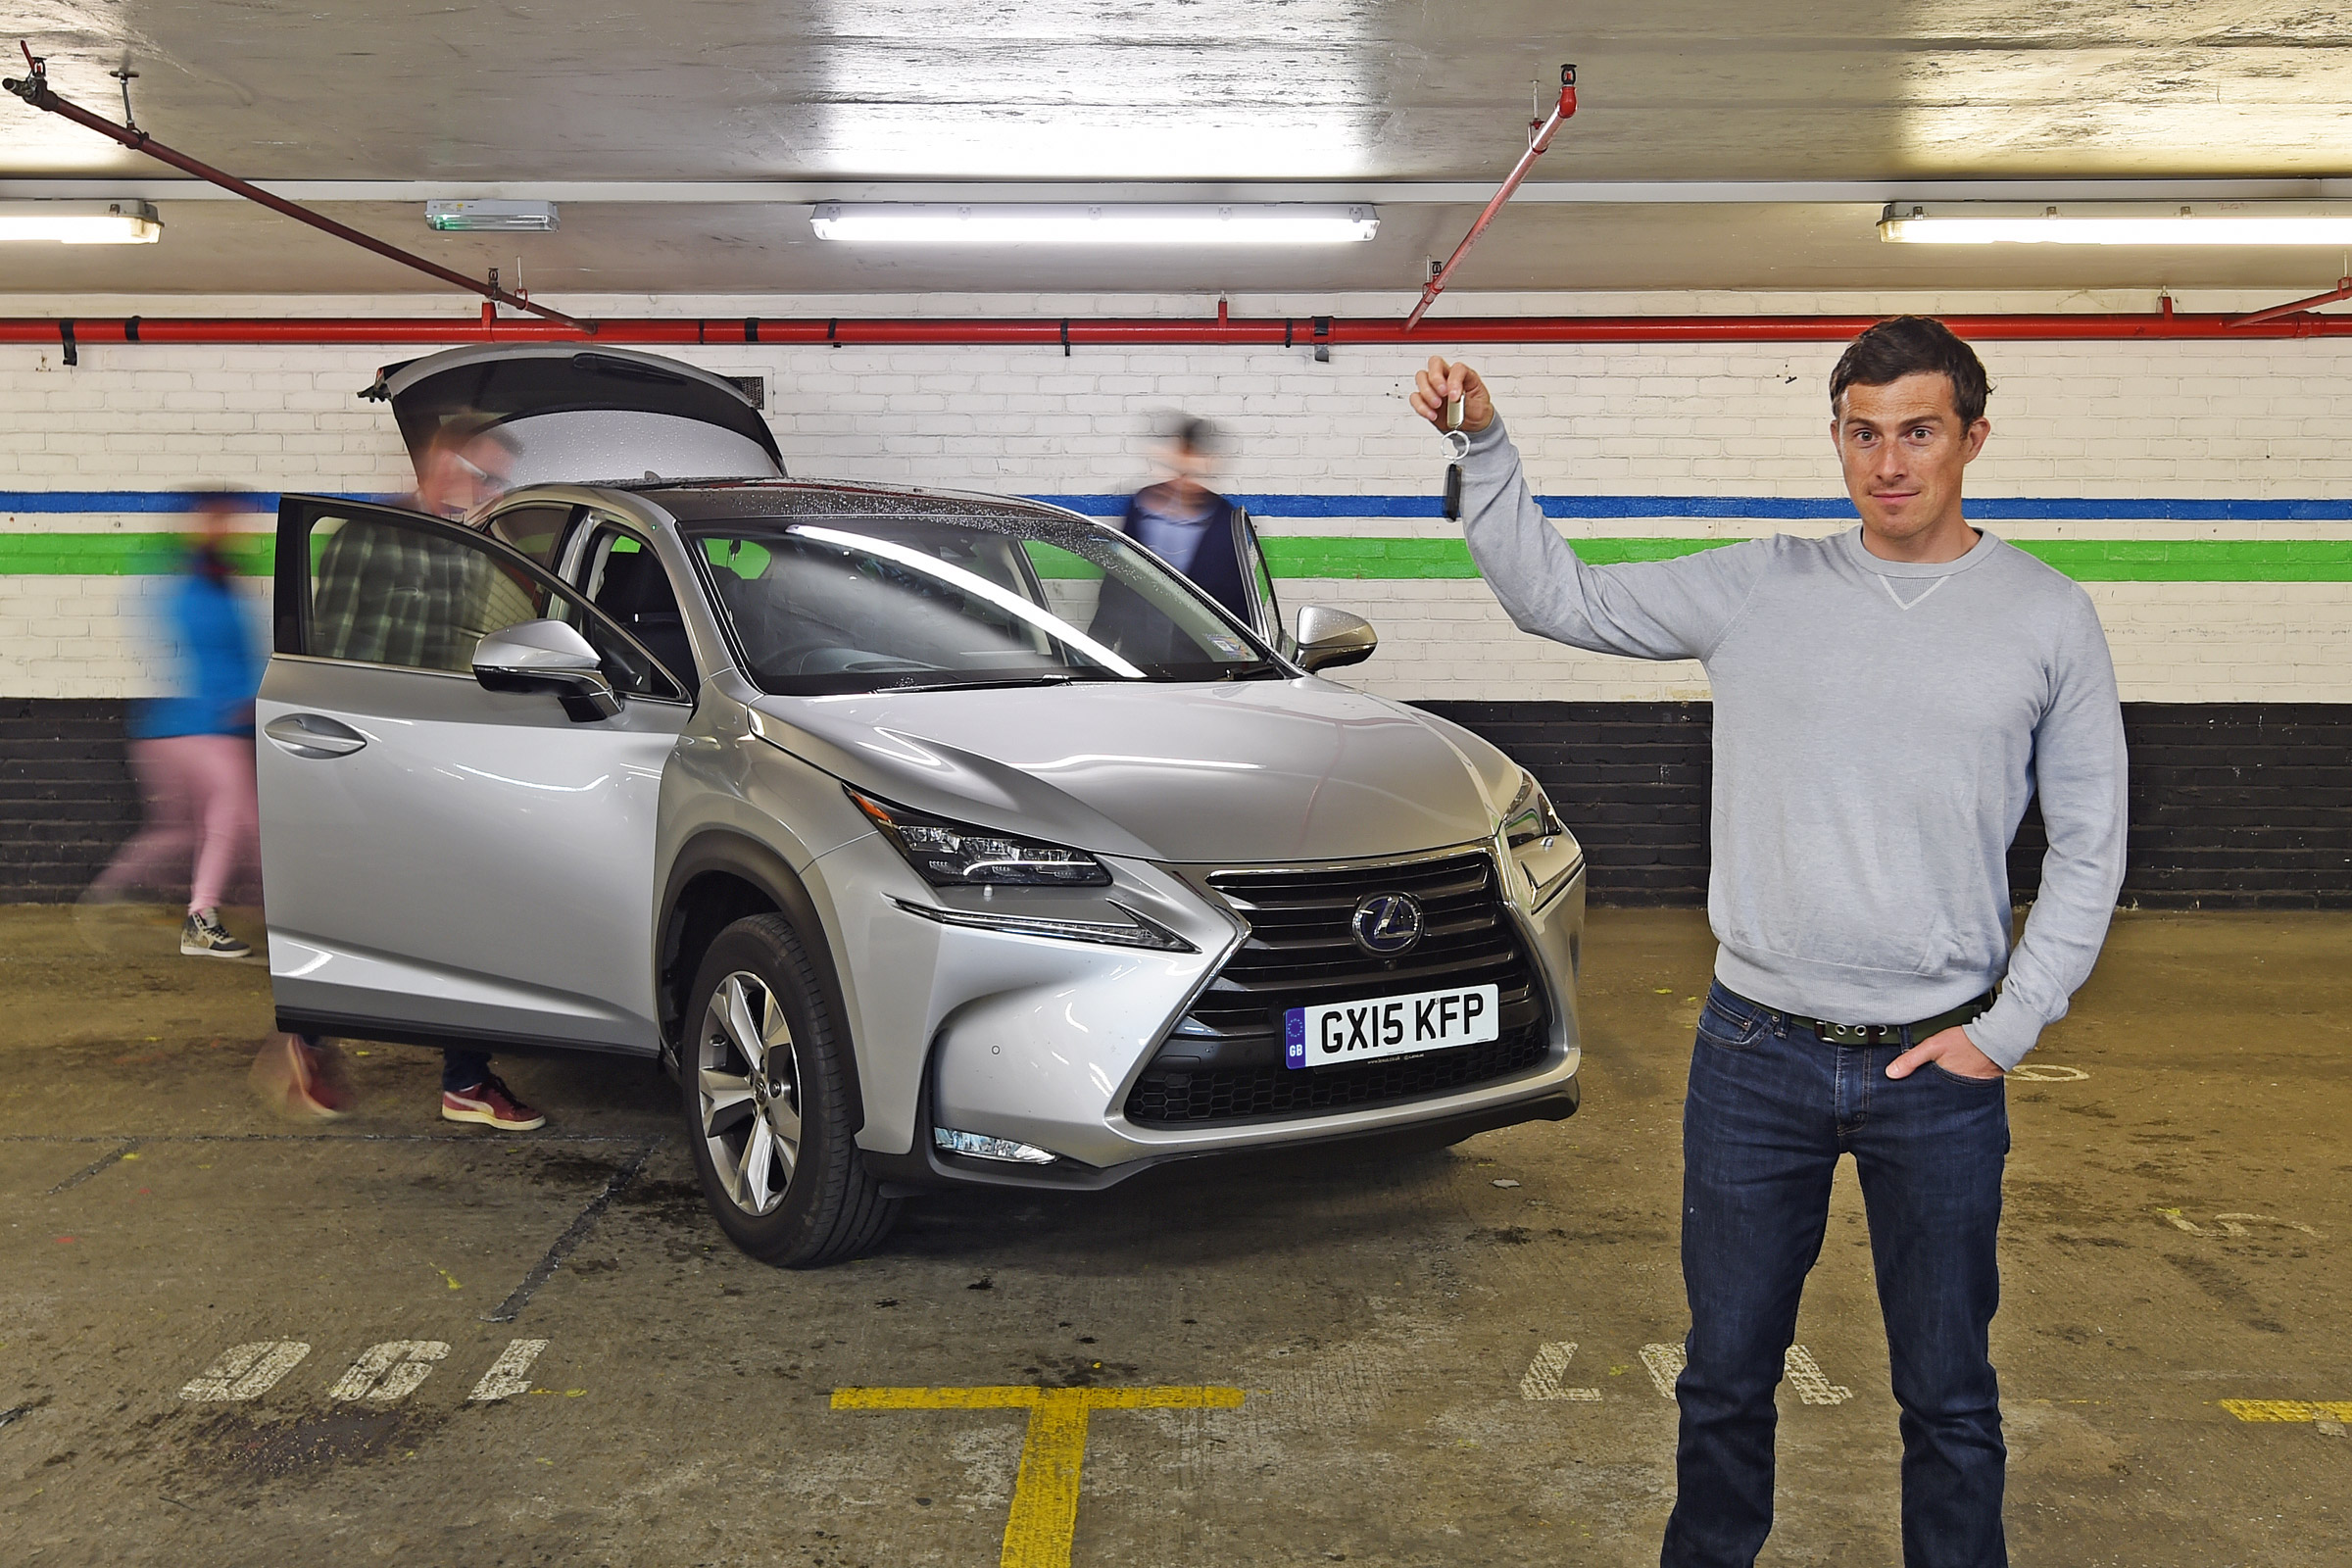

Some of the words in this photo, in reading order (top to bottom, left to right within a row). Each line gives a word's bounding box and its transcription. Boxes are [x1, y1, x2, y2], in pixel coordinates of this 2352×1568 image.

[1320, 1002, 1404, 1054] GX15
[1414, 992, 1485, 1042] KFP
[1289, 1044, 1303, 1057] GB
